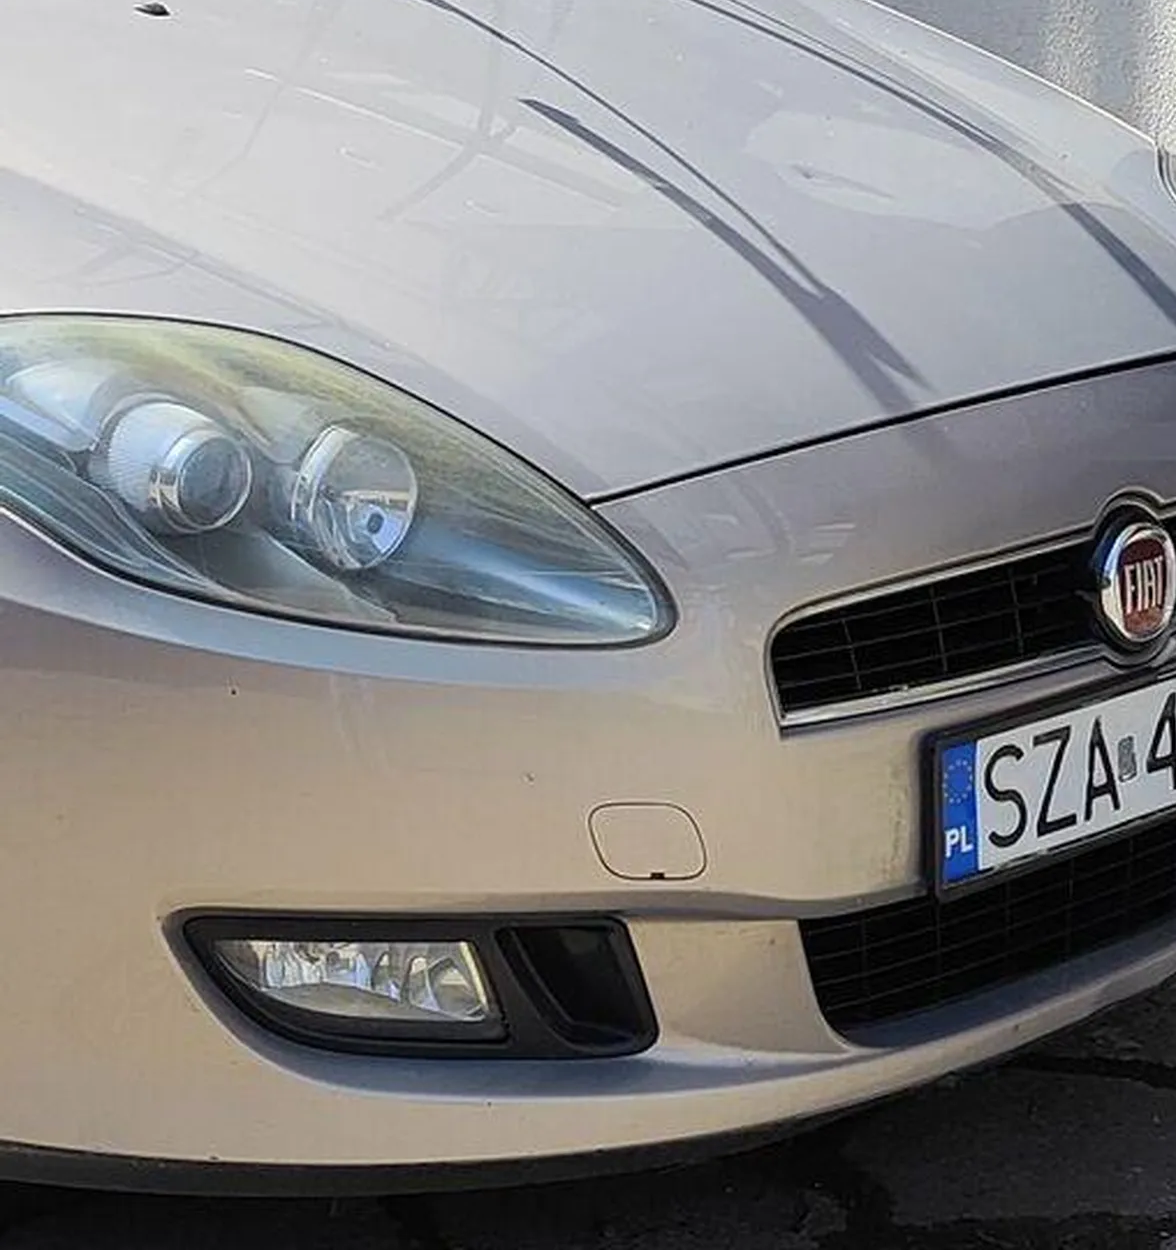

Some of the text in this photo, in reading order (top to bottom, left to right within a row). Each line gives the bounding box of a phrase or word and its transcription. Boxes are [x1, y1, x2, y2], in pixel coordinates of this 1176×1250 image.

[1123, 554, 1164, 615] FIAT
[984, 714, 1121, 849] SZA
[945, 826, 974, 857] PL
